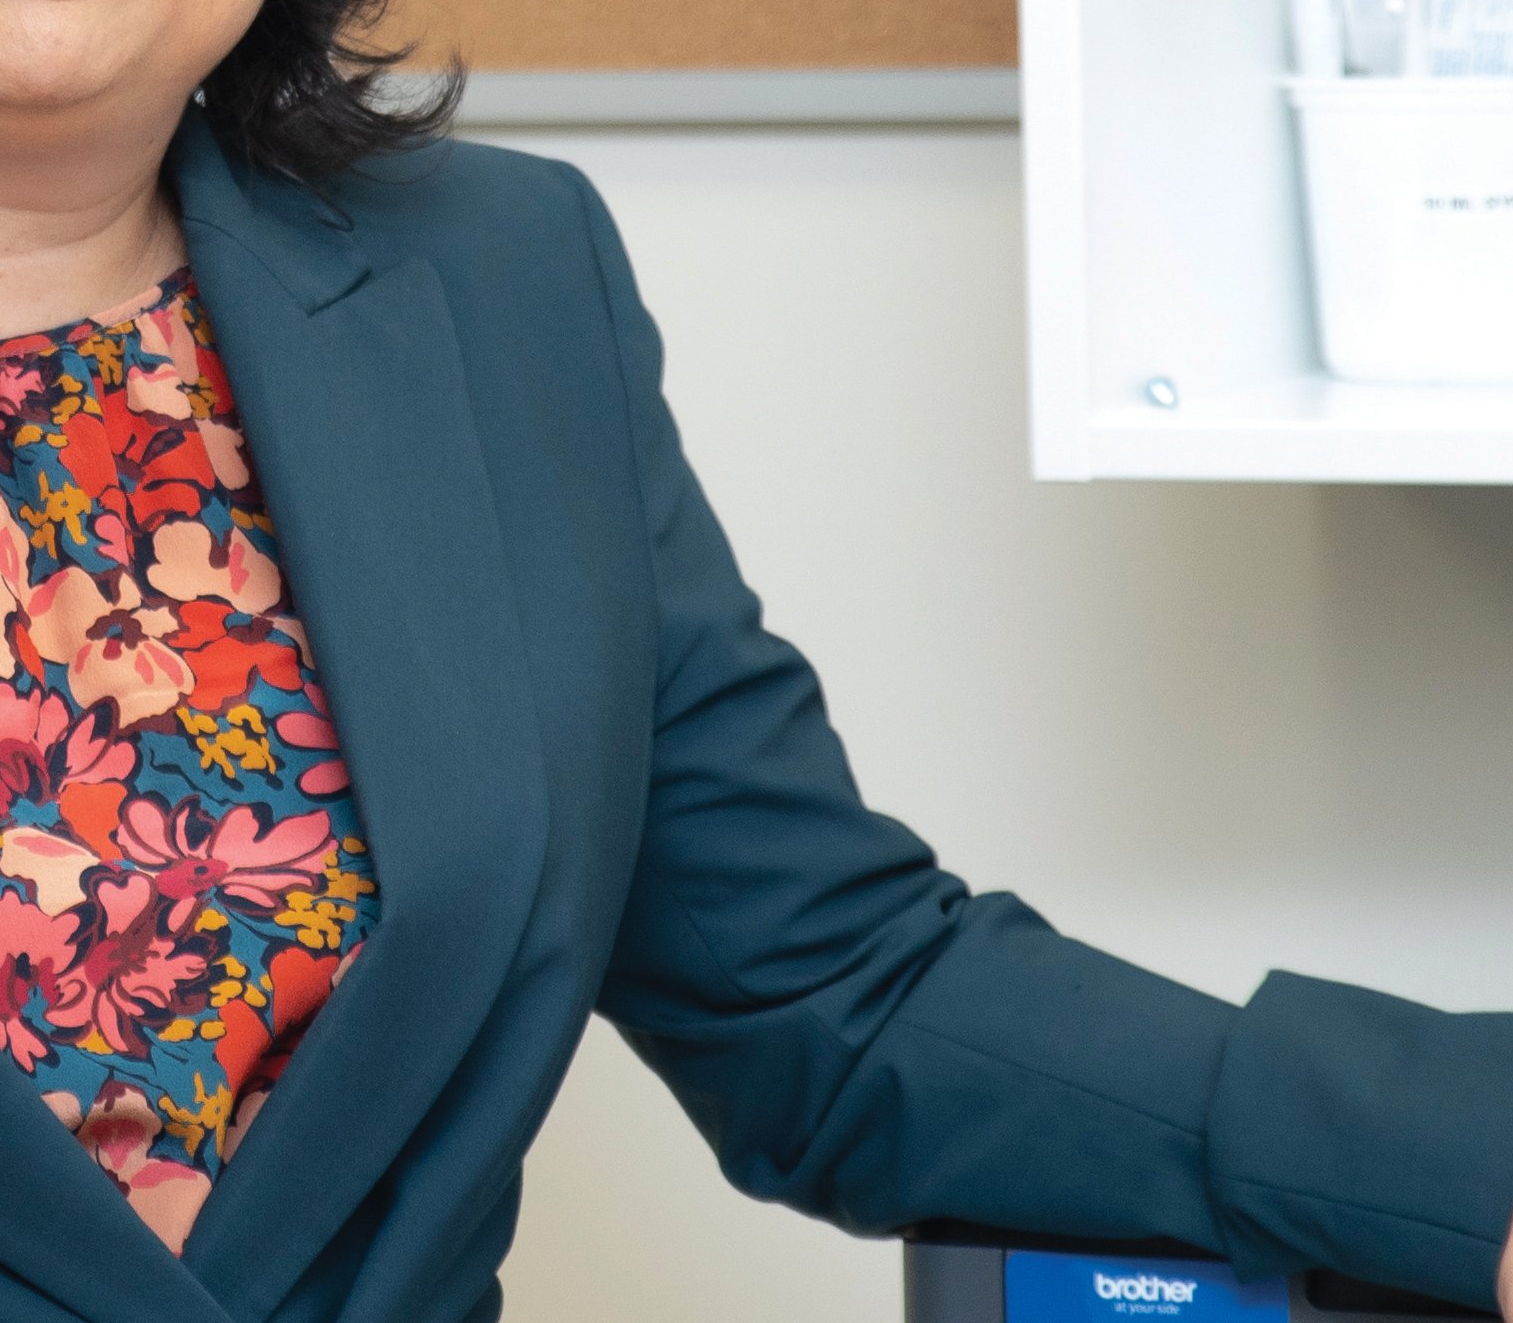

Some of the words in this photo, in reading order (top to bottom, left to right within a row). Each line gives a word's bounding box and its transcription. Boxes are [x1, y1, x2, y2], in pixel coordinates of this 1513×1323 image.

[1094, 1272, 1198, 1303] brother
[1114, 1302, 1127, 1314] at
[1129, 1304, 1156, 1316] your
[1157, 1303, 1181, 1315] side
